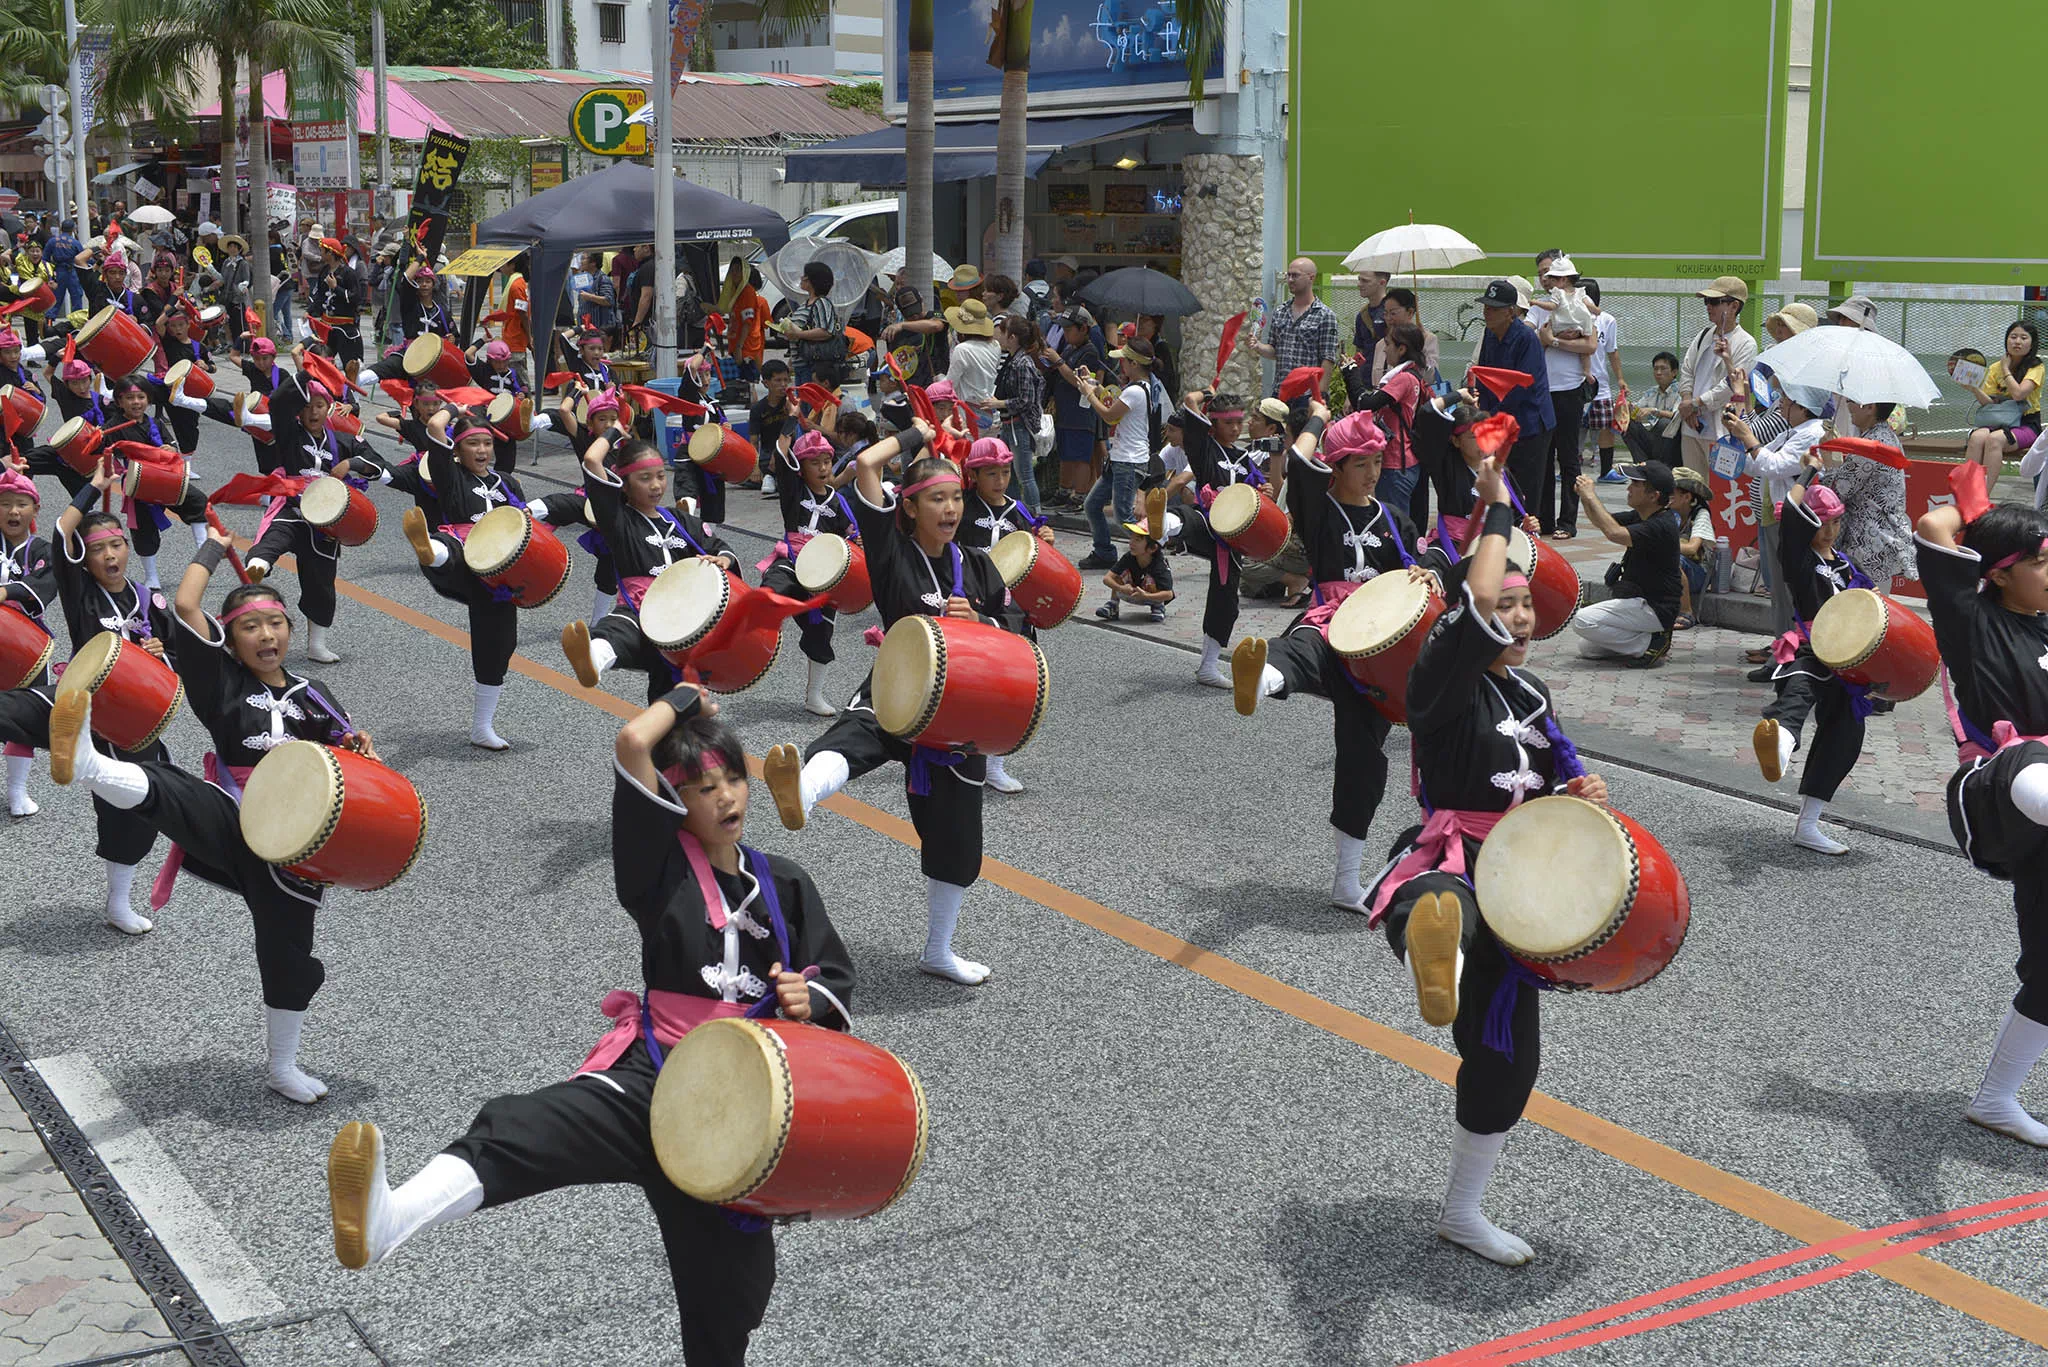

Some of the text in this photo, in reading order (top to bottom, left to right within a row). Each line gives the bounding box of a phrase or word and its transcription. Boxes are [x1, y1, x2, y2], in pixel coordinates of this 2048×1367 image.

[595, 103, 622, 143] P
[430, 134, 467, 154] YUIDAIKO
[625, 141, 644, 153] Repark
[420, 148, 459, 191] 結
[695, 228, 753, 239] CAPTAIN STAG
[1675, 264, 1765, 274] KOKUEIKAN PROJECT
